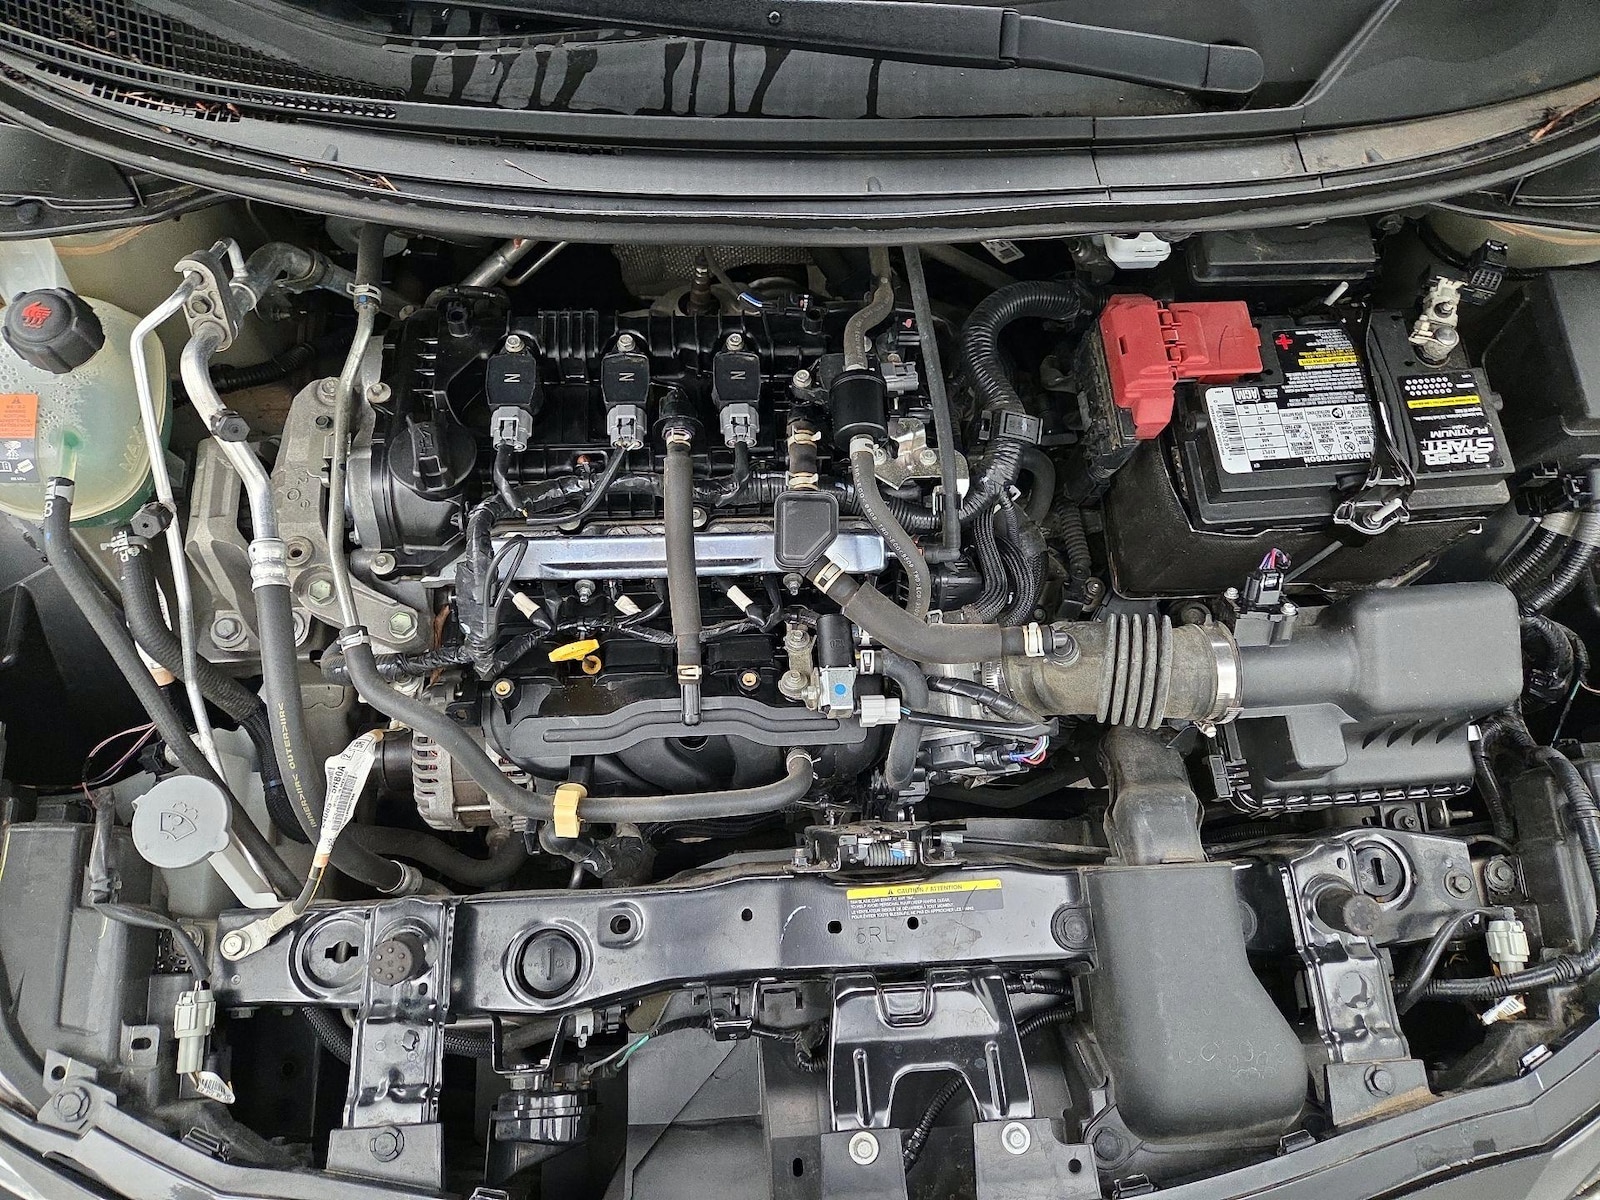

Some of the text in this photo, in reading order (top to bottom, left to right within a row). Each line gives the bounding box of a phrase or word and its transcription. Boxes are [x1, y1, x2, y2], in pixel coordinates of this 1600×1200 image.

[1235, 388, 1257, 400] AGM
[1430, 426, 1488, 437] PLATINUM
[1420, 437, 1494, 455] START
[1303, 453, 1370, 462] DANGER/POISON
[1424, 448, 1489, 466] SUPER
[897, 886, 924, 894] CAUTION
